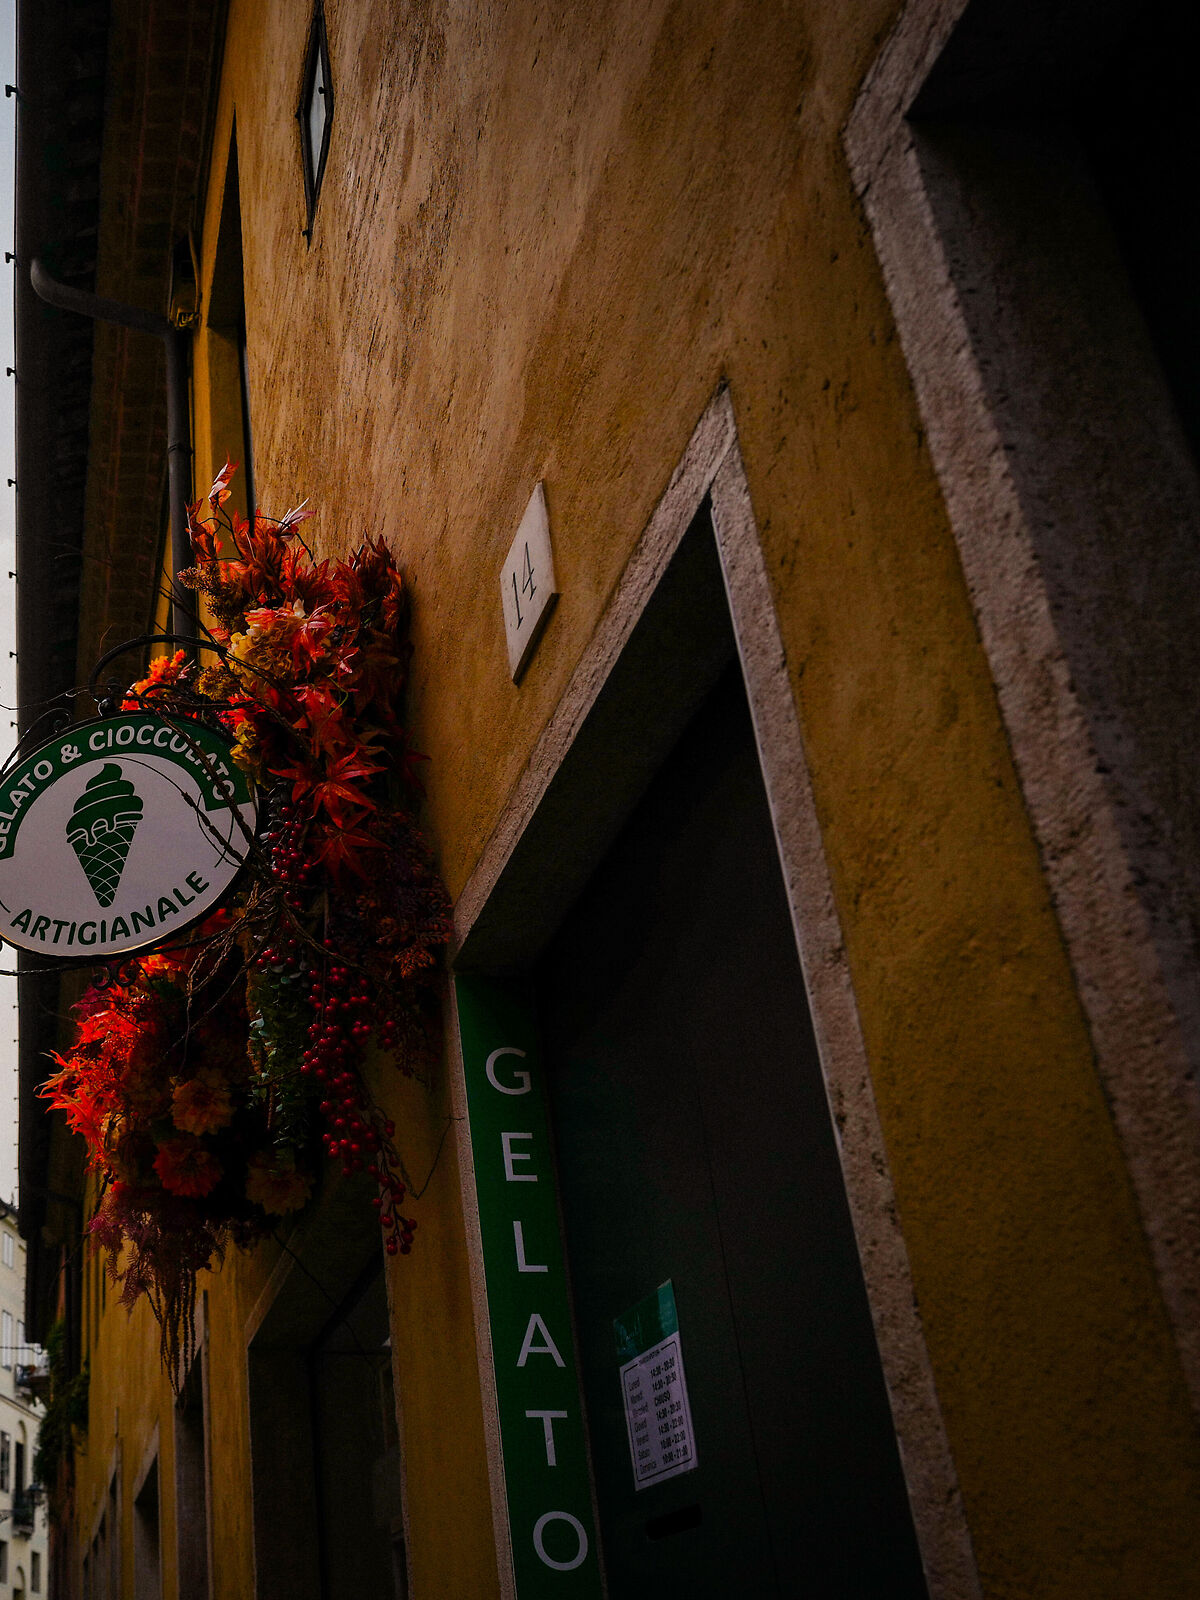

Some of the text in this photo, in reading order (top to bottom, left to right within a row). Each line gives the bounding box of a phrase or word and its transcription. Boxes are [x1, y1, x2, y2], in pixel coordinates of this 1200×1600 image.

[511, 541, 537, 630] 14
[60, 743, 82, 765] &
[10, 870, 210, 945] ARTIGIANALE
[485, 1047, 589, 1571] GELATO
